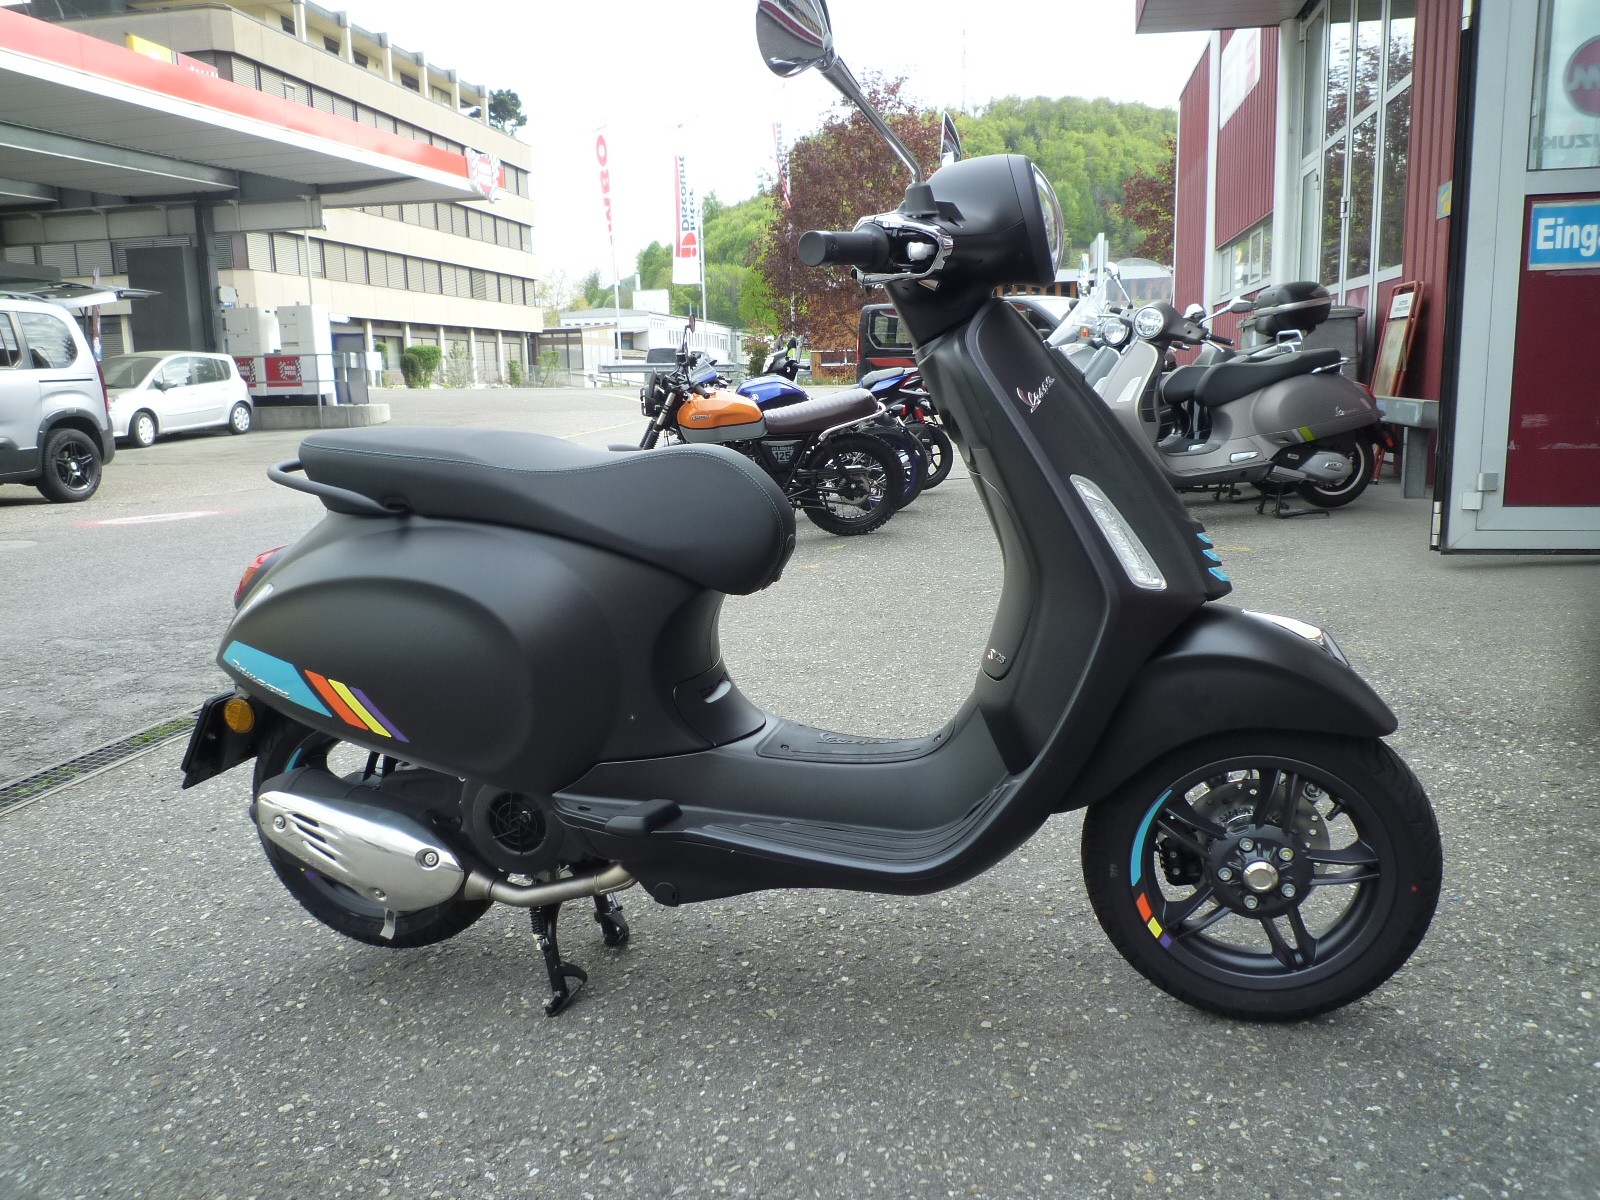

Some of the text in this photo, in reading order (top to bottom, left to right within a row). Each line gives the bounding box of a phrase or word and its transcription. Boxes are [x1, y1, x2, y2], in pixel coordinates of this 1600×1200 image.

[1536, 217, 1600, 257] Eing
[1016, 376, 1055, 413] Vespa
[774, 451, 791, 460] 125
